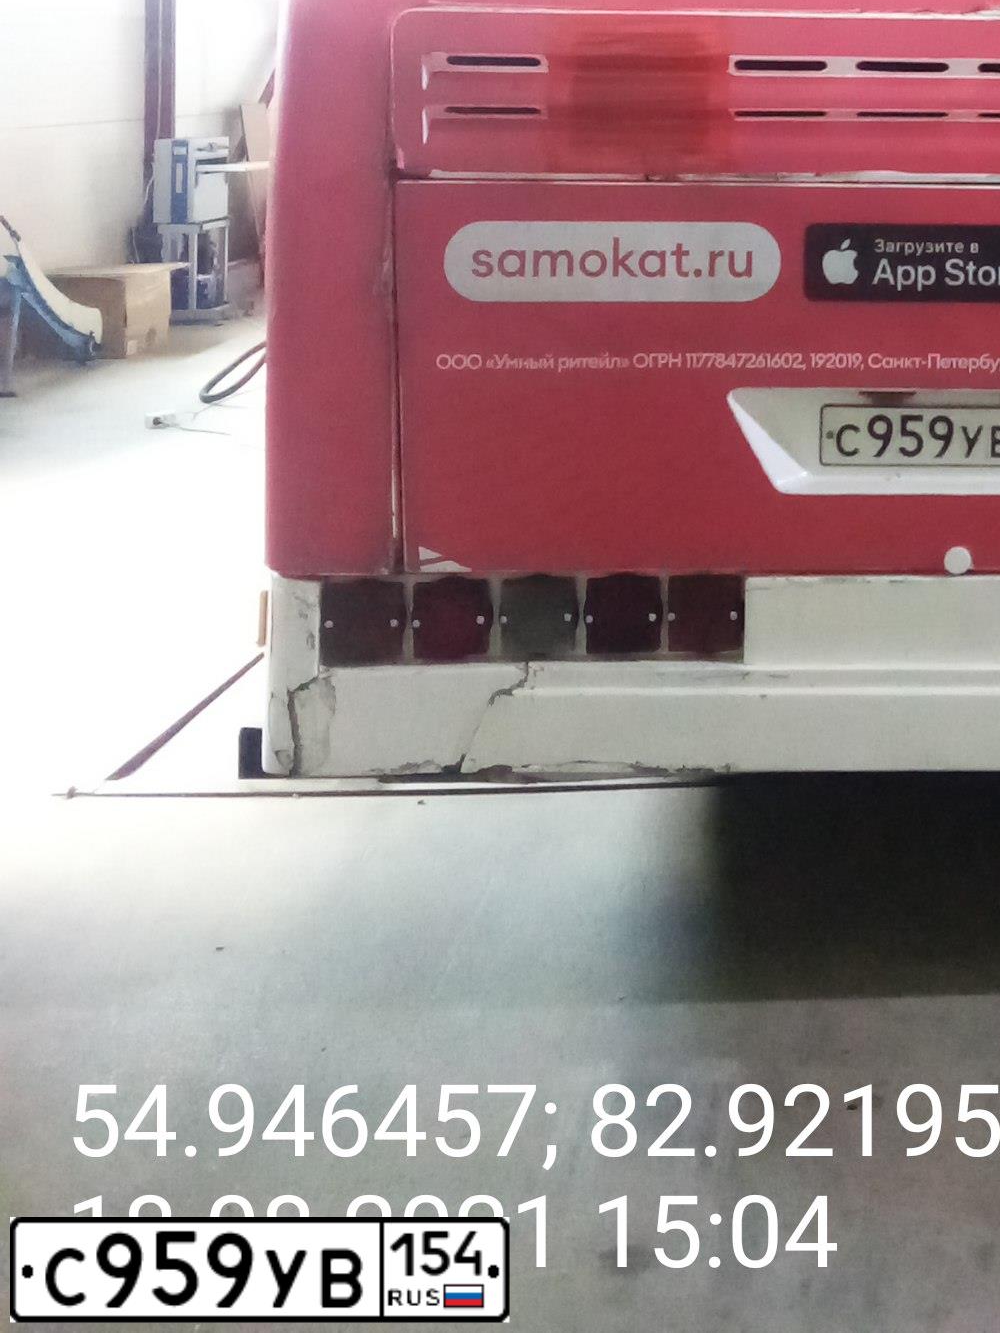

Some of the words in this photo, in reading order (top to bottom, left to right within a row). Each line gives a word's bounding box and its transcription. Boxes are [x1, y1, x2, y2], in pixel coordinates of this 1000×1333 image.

[471, 237, 753, 279] samokat.ru
[874, 238, 964, 256] Загрузите
[969, 242, 979, 253] в
[872, 258, 936, 291] App
[436, 354, 482, 369] ООО
[633, 353, 682, 368] ОГРН
[810, 353, 864, 370] 192019,
